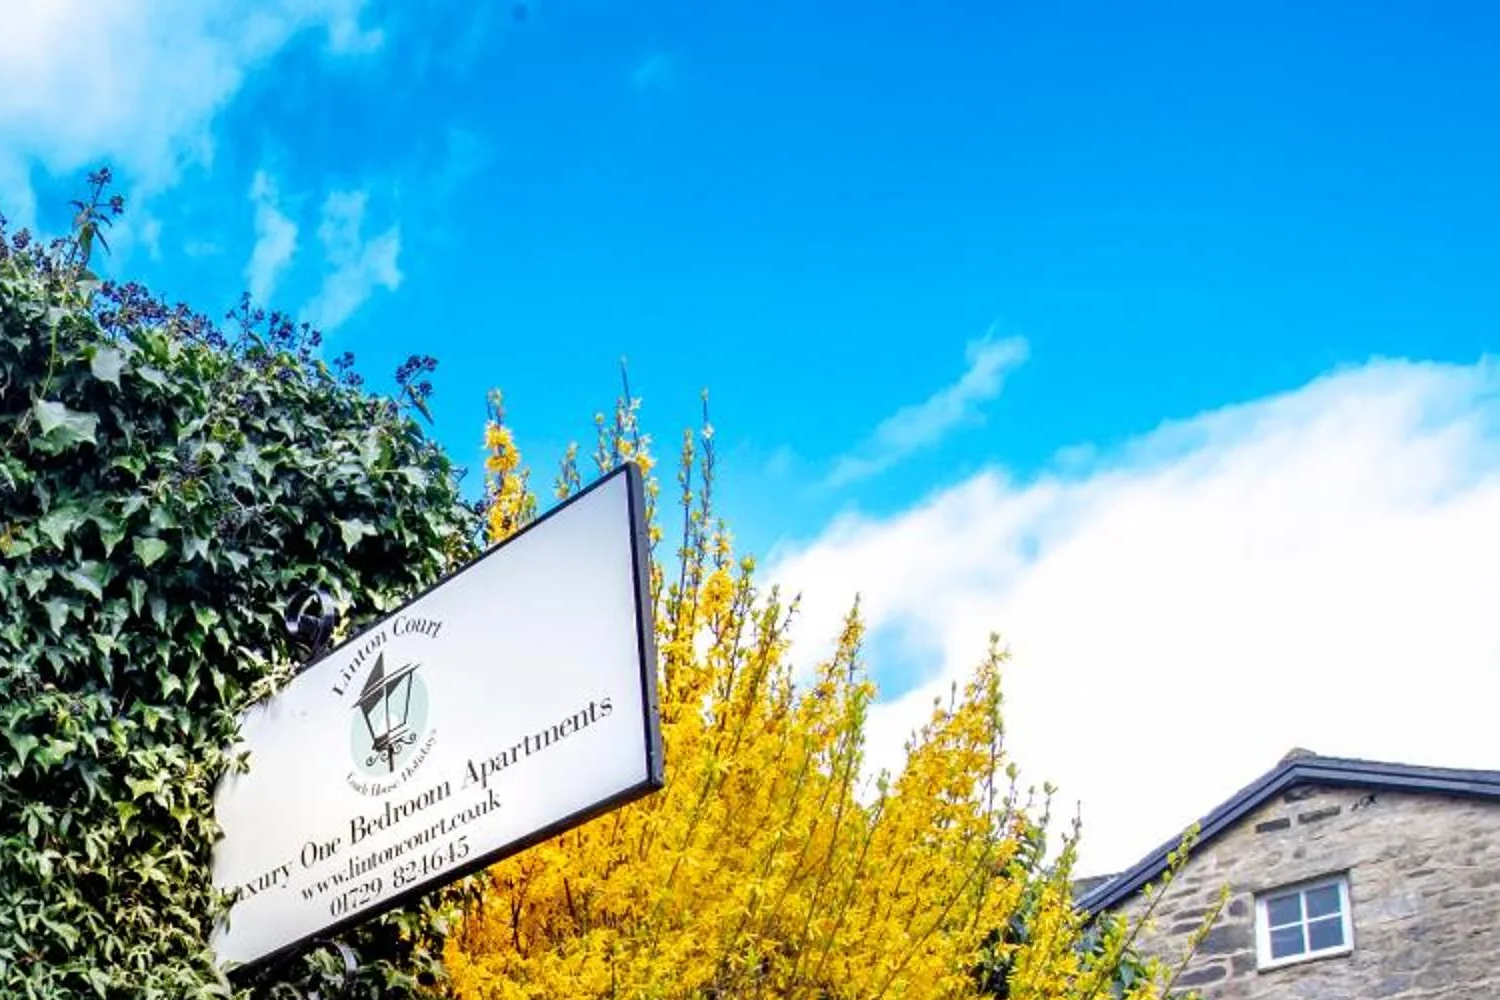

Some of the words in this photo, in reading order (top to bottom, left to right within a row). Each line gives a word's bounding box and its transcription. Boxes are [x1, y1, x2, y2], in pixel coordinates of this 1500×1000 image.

[332, 630, 387, 696] Linton
[393, 615, 442, 639] Court
[300, 836, 342, 870] One
[350, 780, 452, 846] Bedroom
[461, 696, 613, 789] Apartments
[301, 789, 502, 901] www.lintoncourt.co.uk
[330, 876, 383, 917] 01729
[392, 834, 471, 890] 824645
